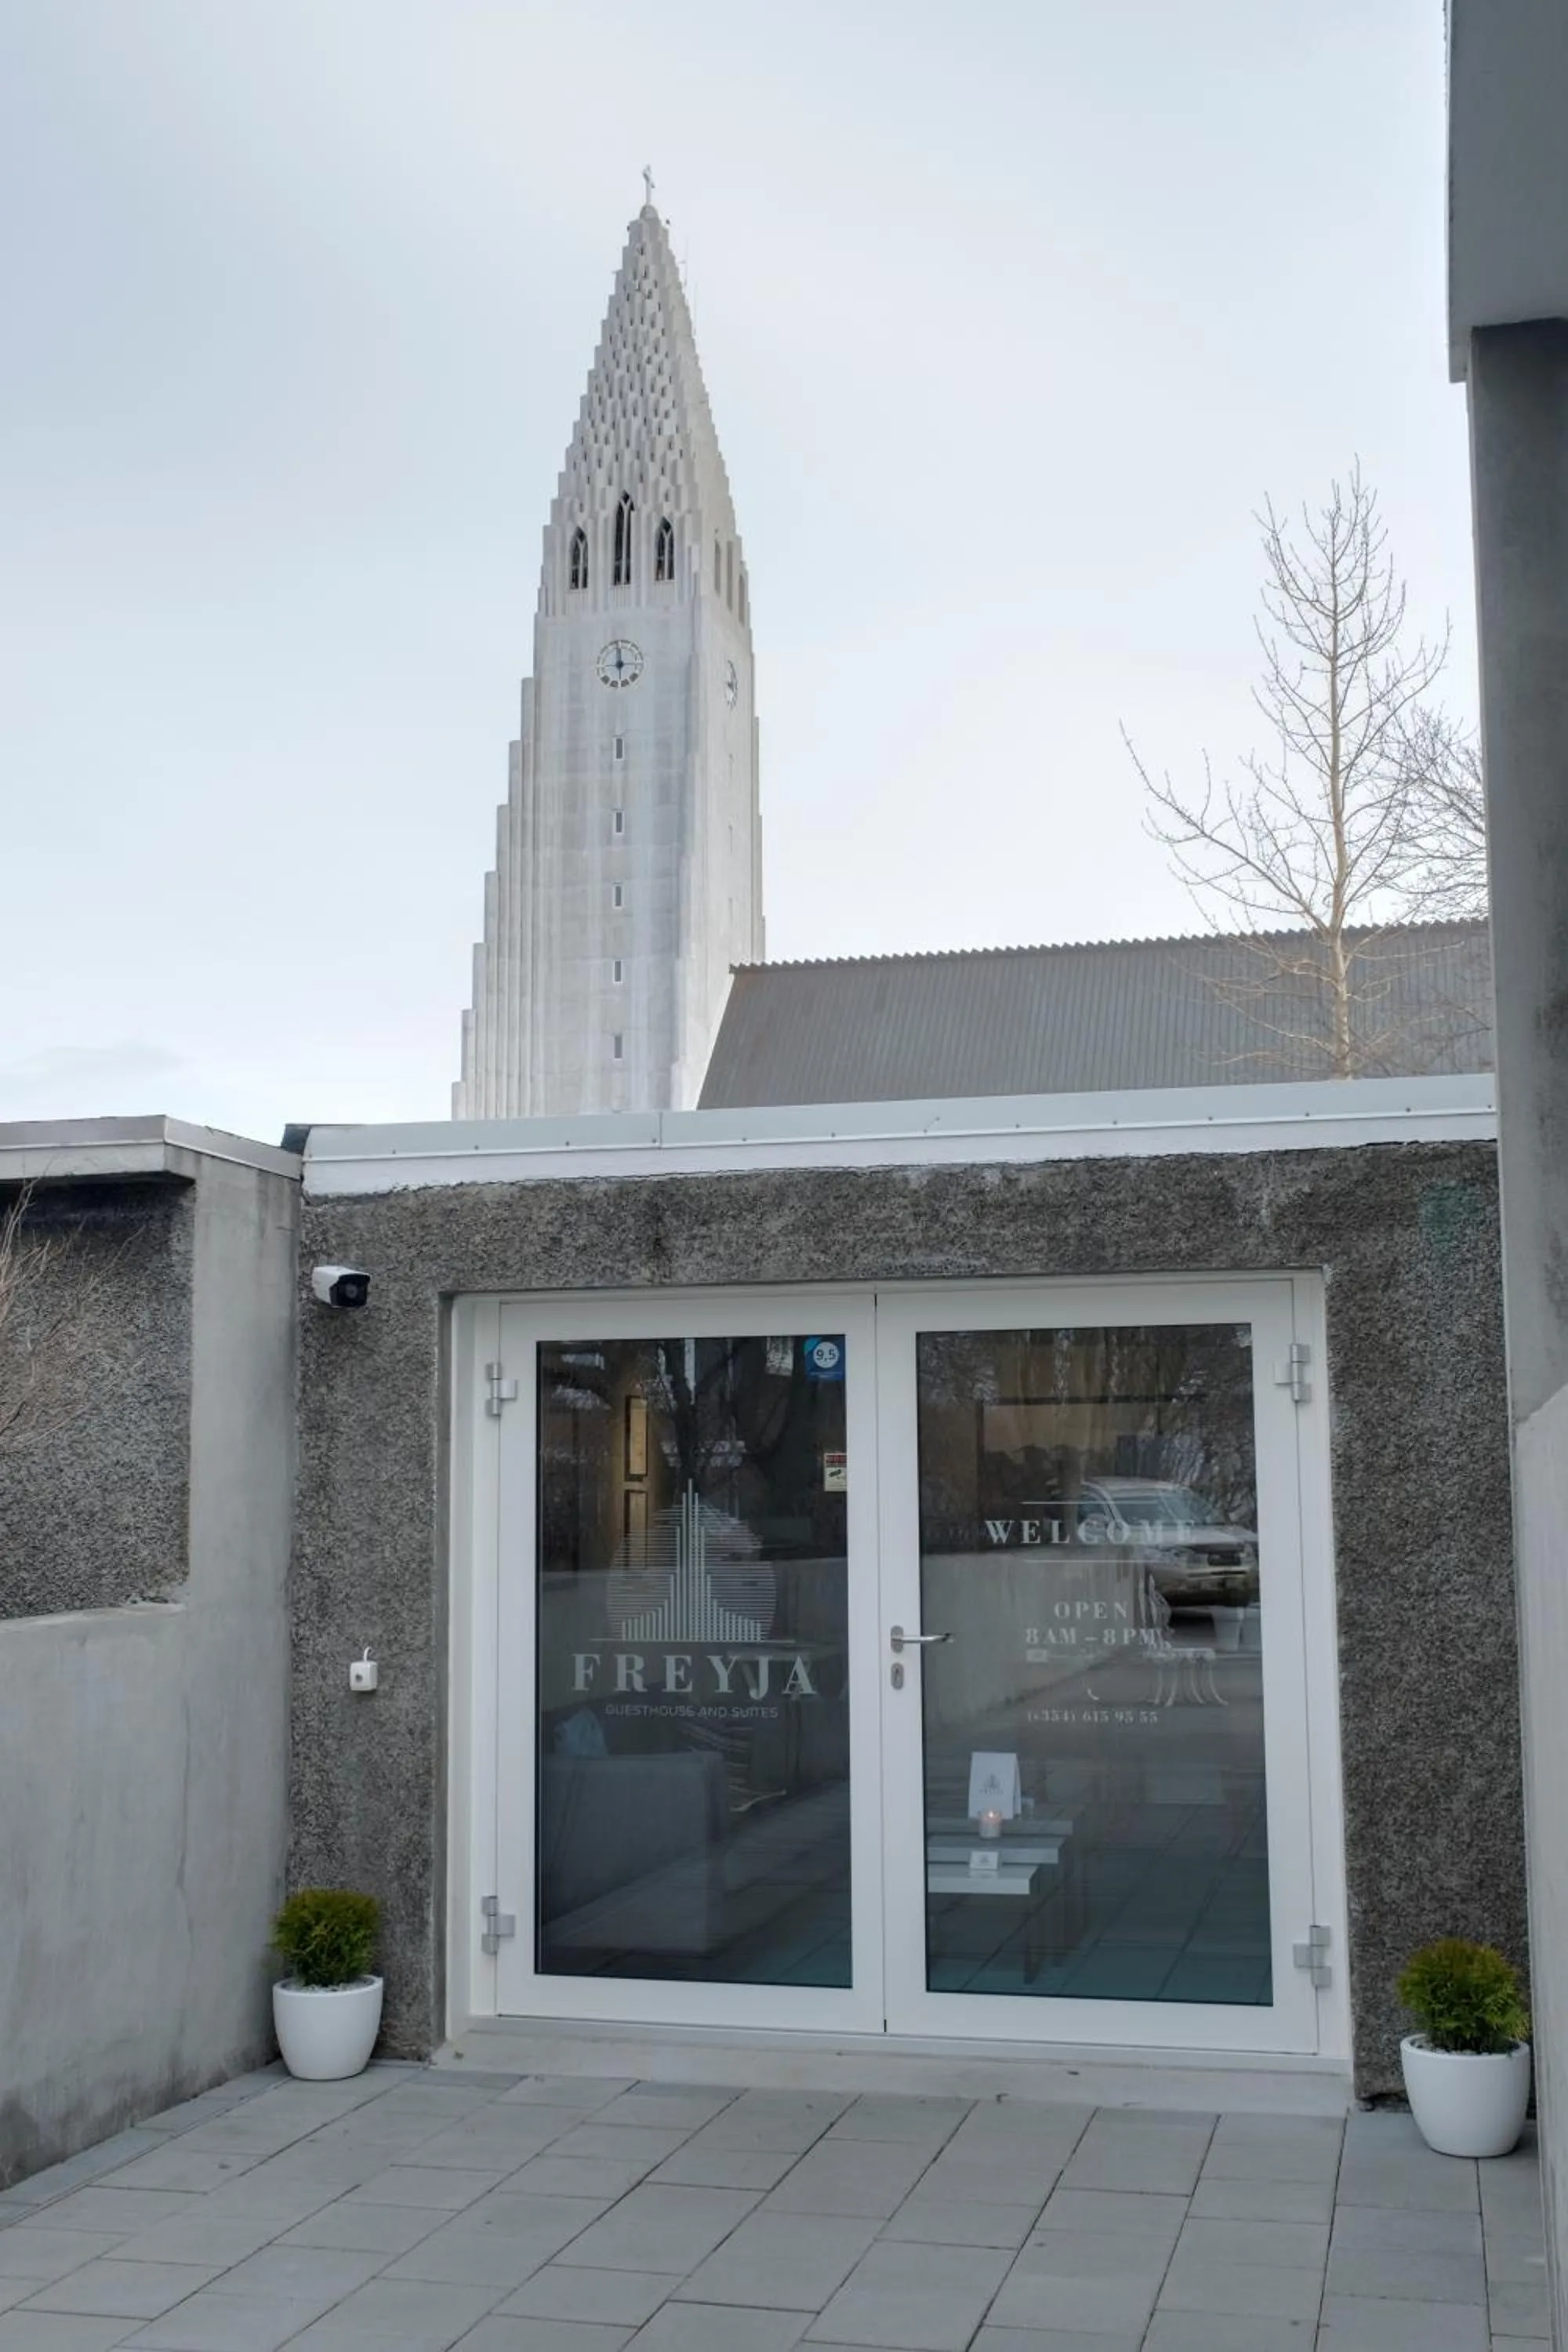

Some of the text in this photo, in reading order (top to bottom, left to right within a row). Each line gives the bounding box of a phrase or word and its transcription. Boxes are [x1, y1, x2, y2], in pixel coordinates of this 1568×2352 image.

[984, 1519, 1194, 1544] WELCOME
[1054, 1601, 1128, 1621] OPEN
[1025, 1628, 1039, 1645] 8
[1044, 1628, 1076, 1645] AM
[1103, 1628, 1116, 1645] 8
[1123, 1629, 1162, 1646] PM
[571, 1653, 817, 1700] FREYJA
[604, 1704, 779, 1719] GUESTHOUSE AND SUITES
